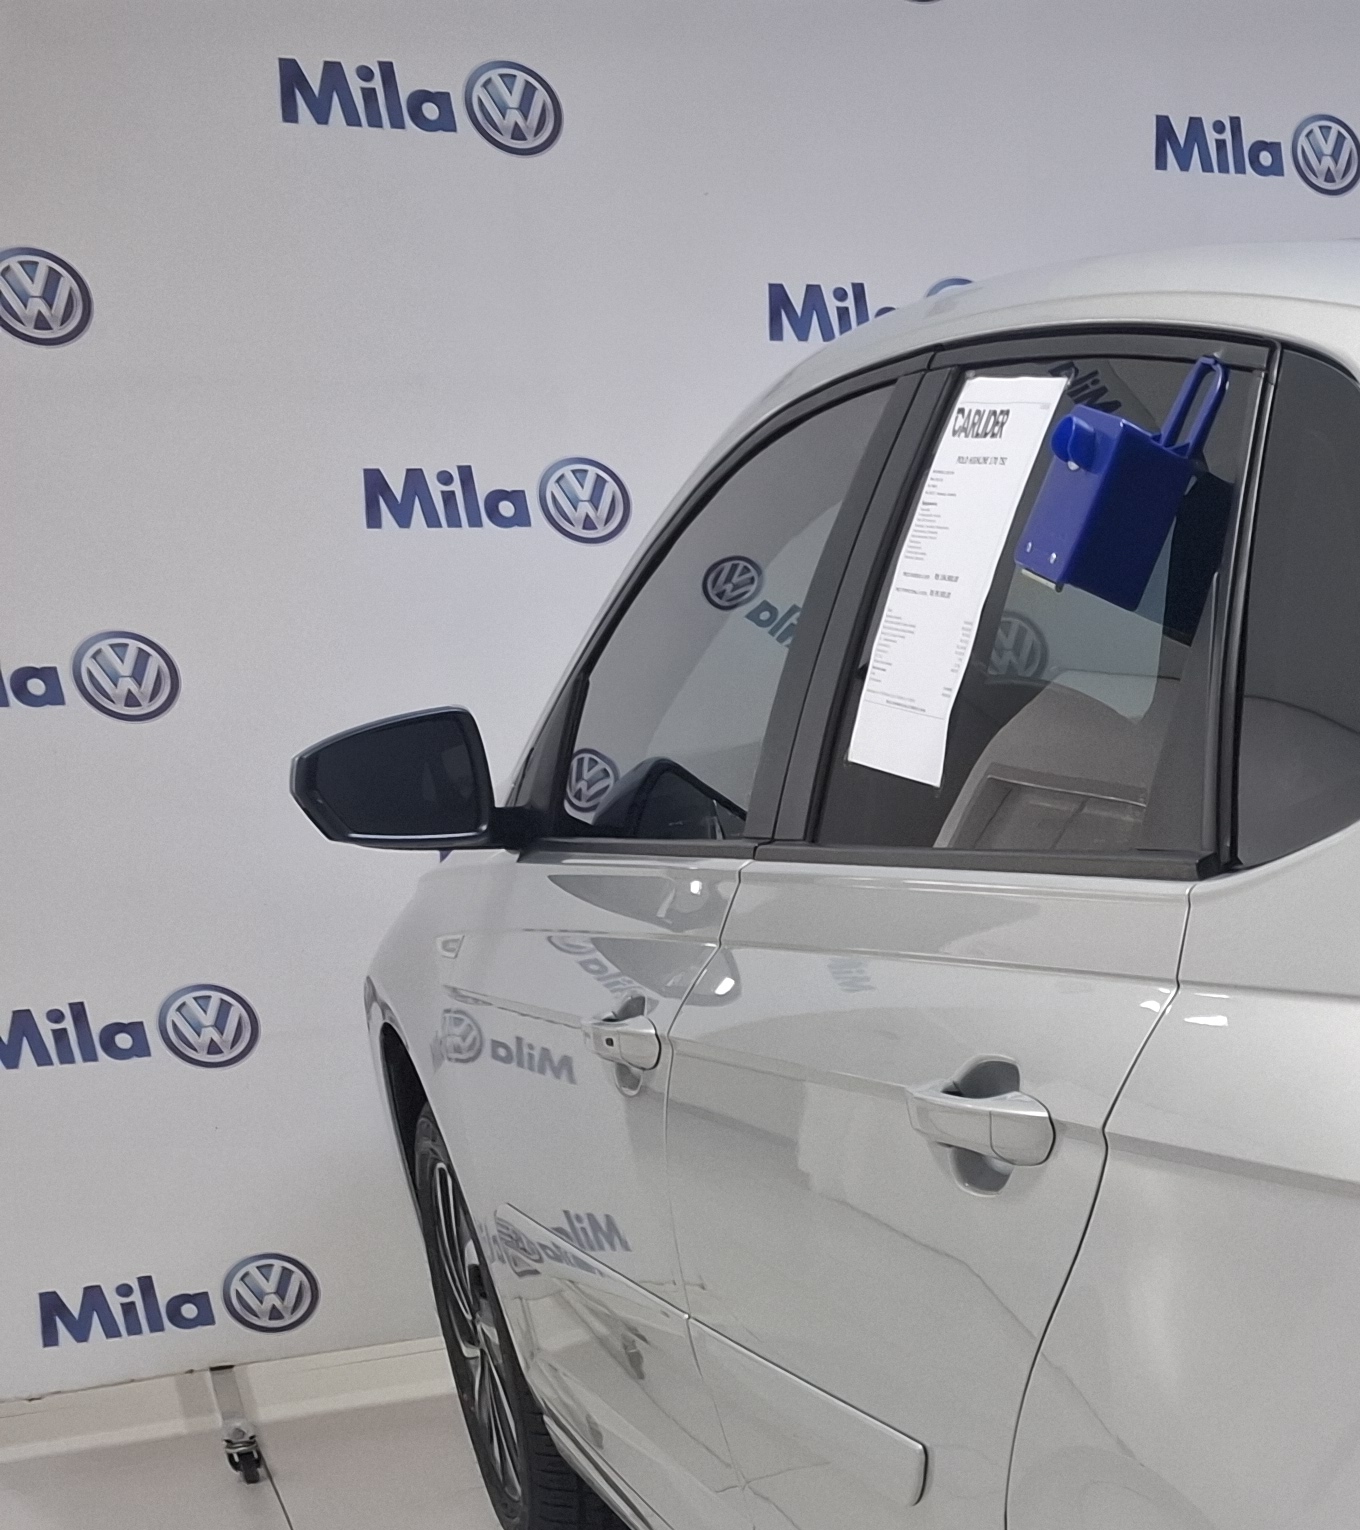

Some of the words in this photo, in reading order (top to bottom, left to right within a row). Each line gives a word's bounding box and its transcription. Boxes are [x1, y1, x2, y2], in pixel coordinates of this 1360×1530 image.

[278, 57, 458, 133] Mila
[1154, 114, 1285, 176] Mila
[768, 283, 896, 342] Mil
[952, 407, 1010, 439] CARLIDER
[363, 465, 532, 529] Mila
[38, 1276, 215, 1348] Mila
